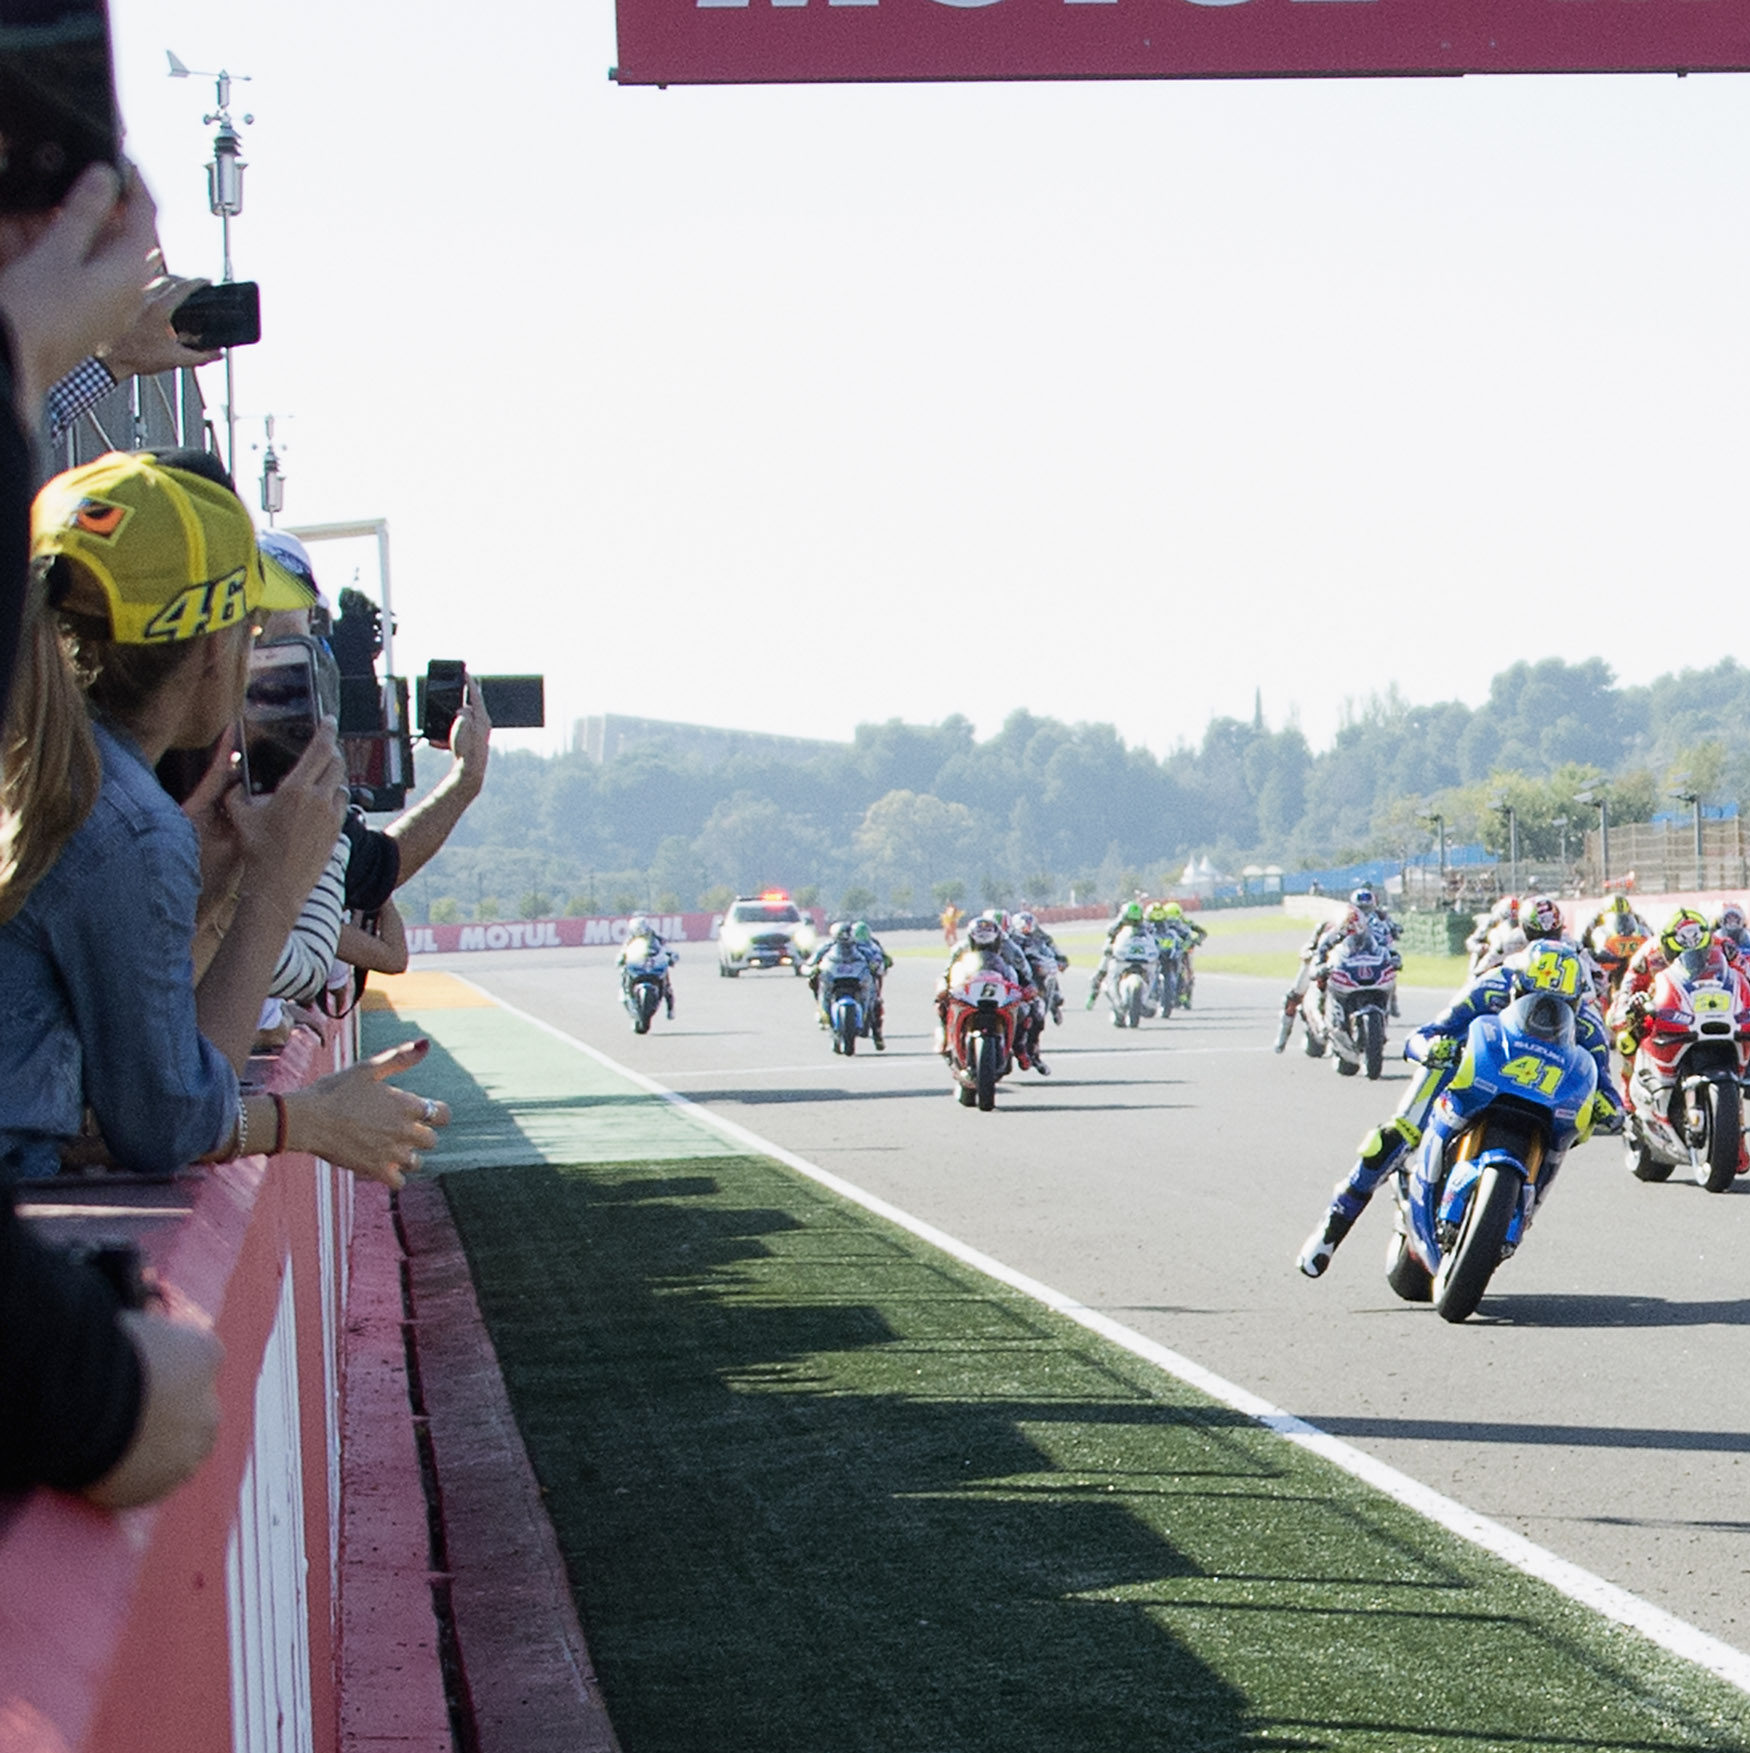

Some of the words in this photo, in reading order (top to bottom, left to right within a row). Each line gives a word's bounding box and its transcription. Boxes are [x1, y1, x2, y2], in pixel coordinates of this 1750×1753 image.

[144, 566, 248, 640] 46
[458, 921, 562, 951] MOTUL
[582, 916, 688, 946] MOUL
[1526, 951, 1581, 996] 41
[1499, 1055, 1564, 1097] 41
